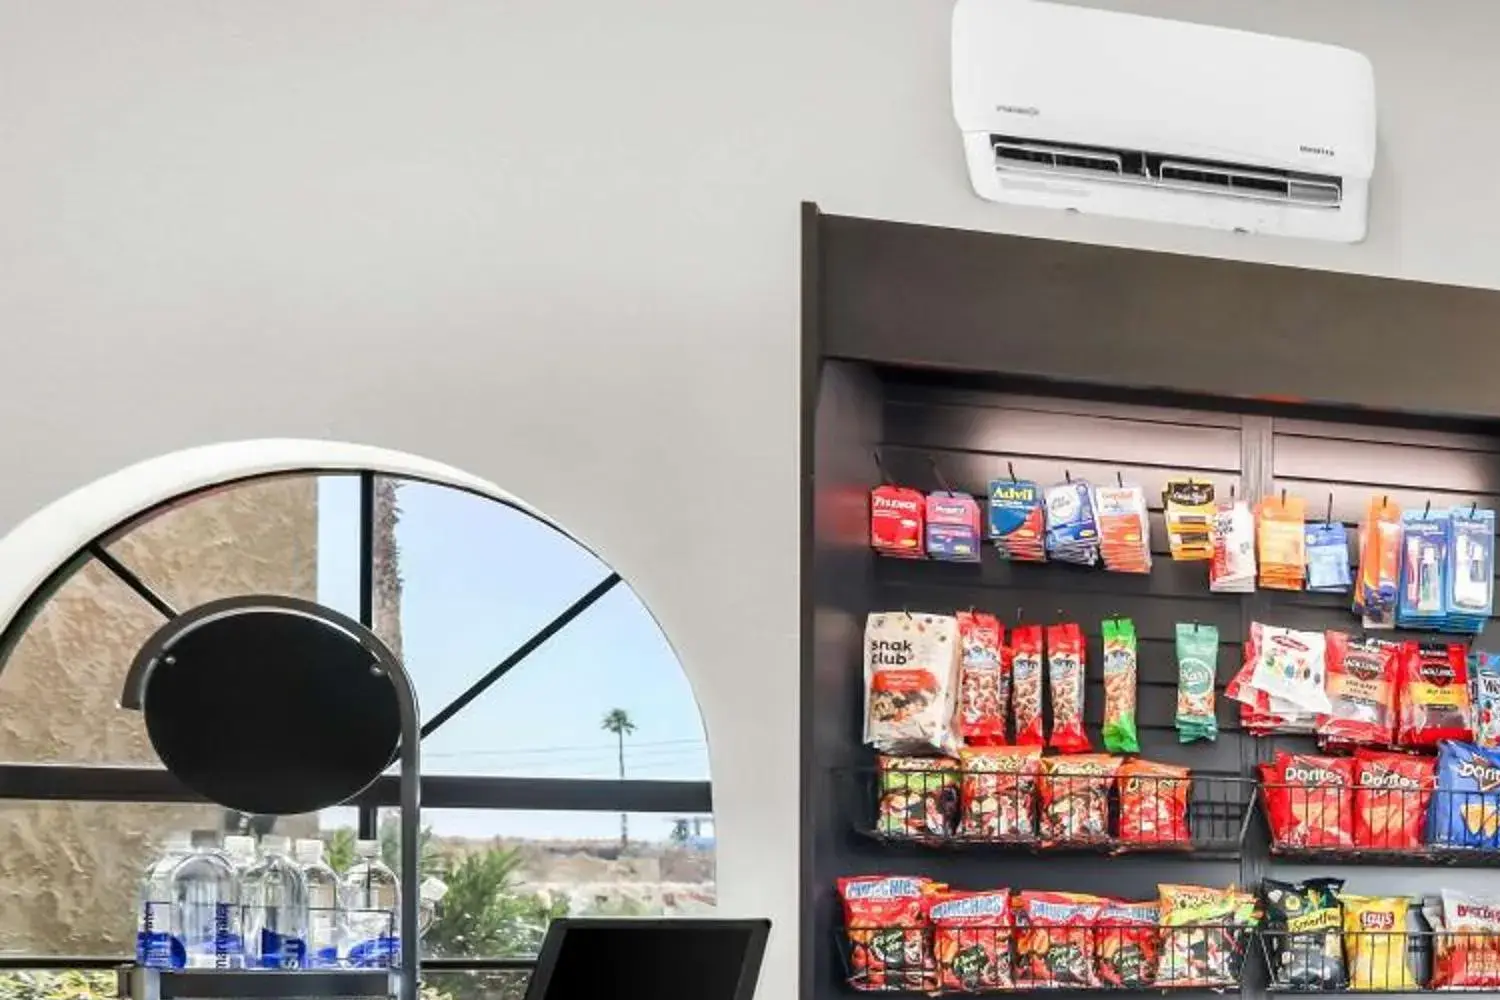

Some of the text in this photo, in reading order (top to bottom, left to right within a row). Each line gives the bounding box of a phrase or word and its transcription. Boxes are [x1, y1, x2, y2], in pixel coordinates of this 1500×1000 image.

[993, 487, 1034, 501] Advil
[871, 639, 912, 652] snak
[871, 653, 908, 665] club
[1285, 767, 1343, 785] Doritos
[1360, 771, 1419, 788] Doritos
[1362, 911, 1395, 928] Lay's
